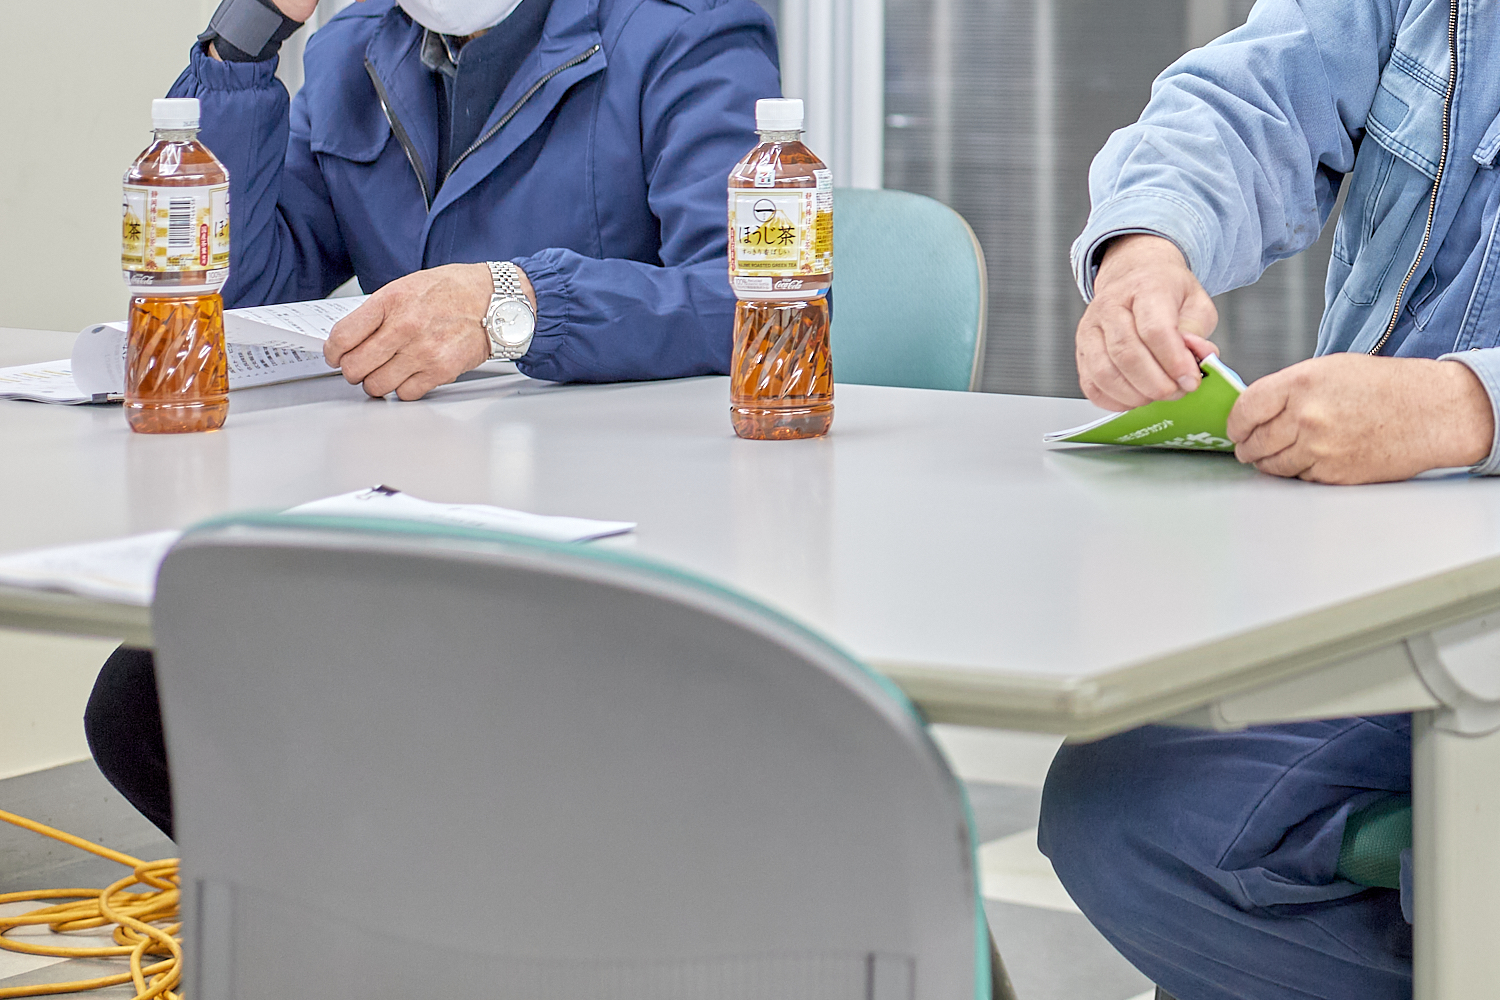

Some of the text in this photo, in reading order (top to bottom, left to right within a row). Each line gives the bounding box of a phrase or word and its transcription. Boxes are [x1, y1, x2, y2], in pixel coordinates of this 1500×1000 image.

[738, 225, 796, 246] ほうじ茶
[742, 248, 791, 256] すっきり香ばしい
